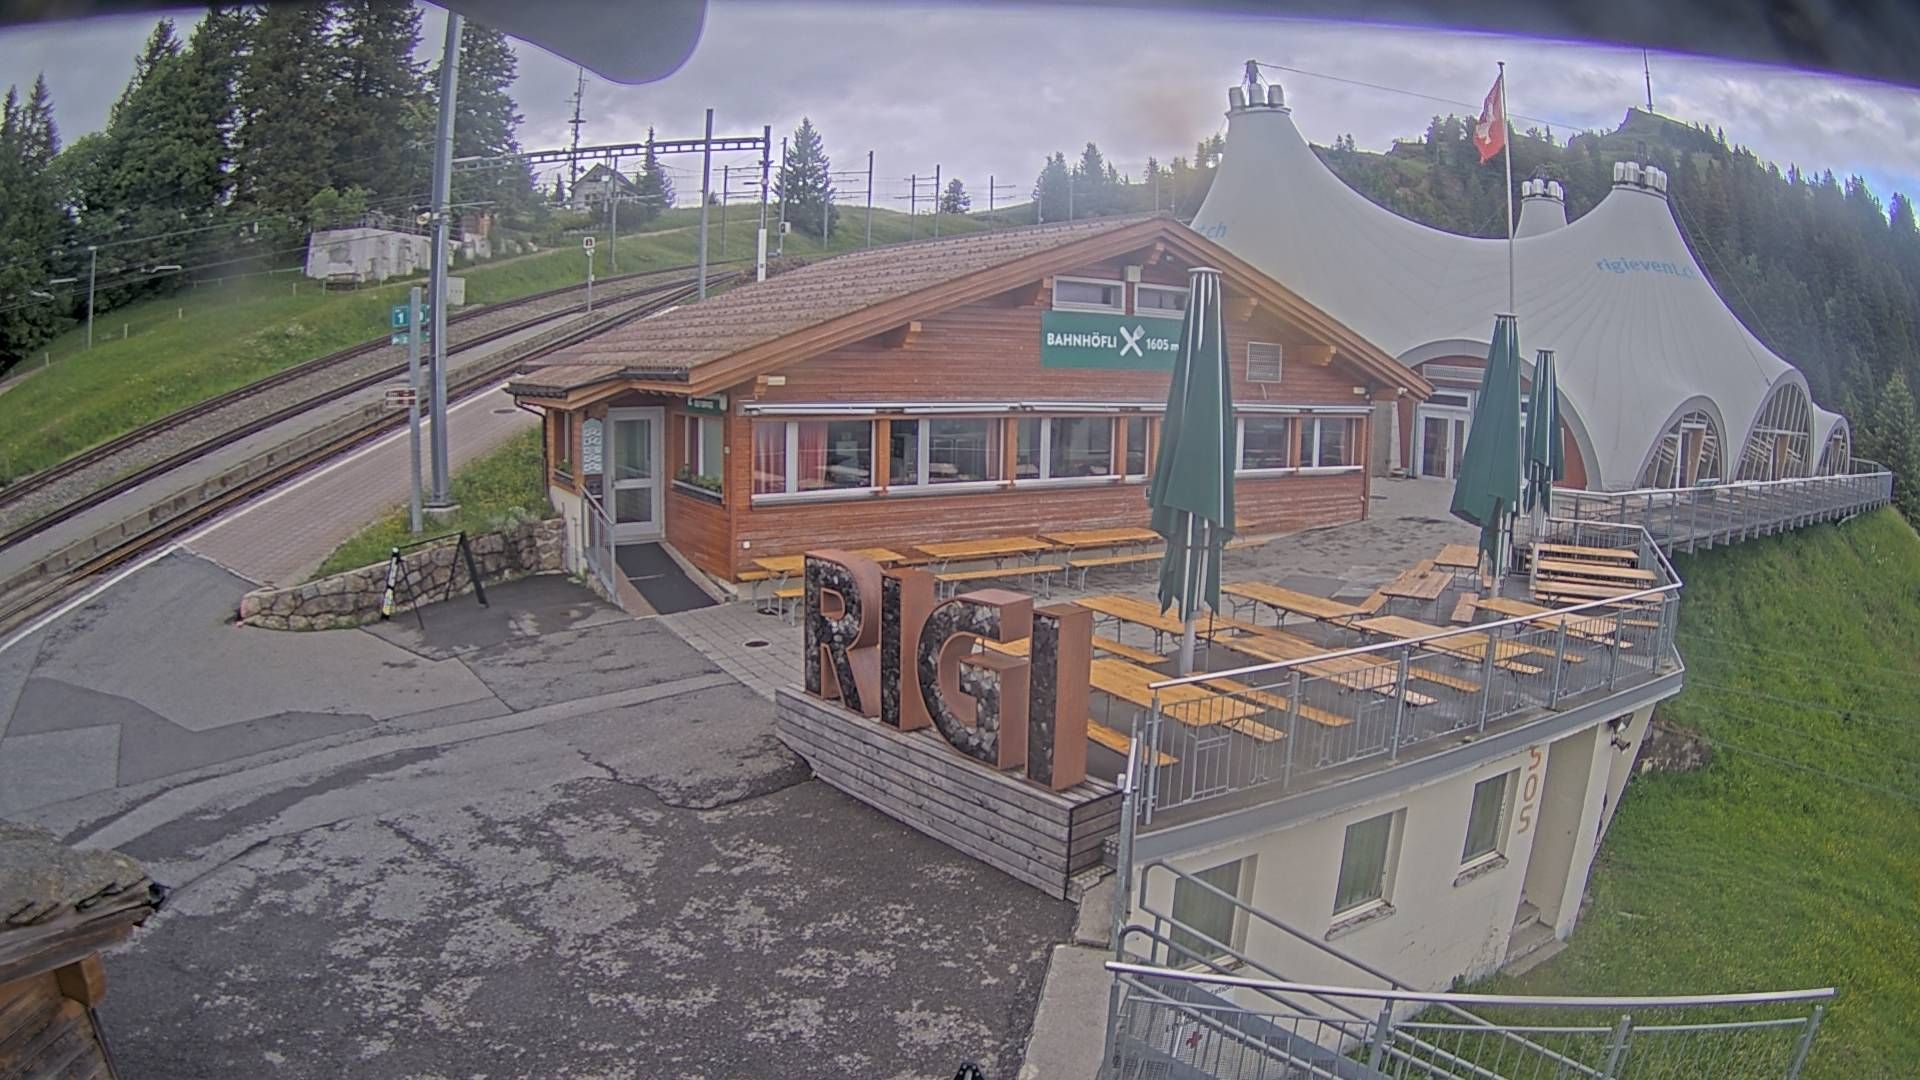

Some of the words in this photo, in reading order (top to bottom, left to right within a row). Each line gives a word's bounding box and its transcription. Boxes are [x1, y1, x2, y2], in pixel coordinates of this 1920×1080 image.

[397, 311, 405, 325] 1
[1046, 331, 1118, 349] BAHNHÖFLI
[1145, 337, 1170, 351] 1605
[804, 550, 1091, 792] RIGI
[1516, 744, 1542, 835] SOS
